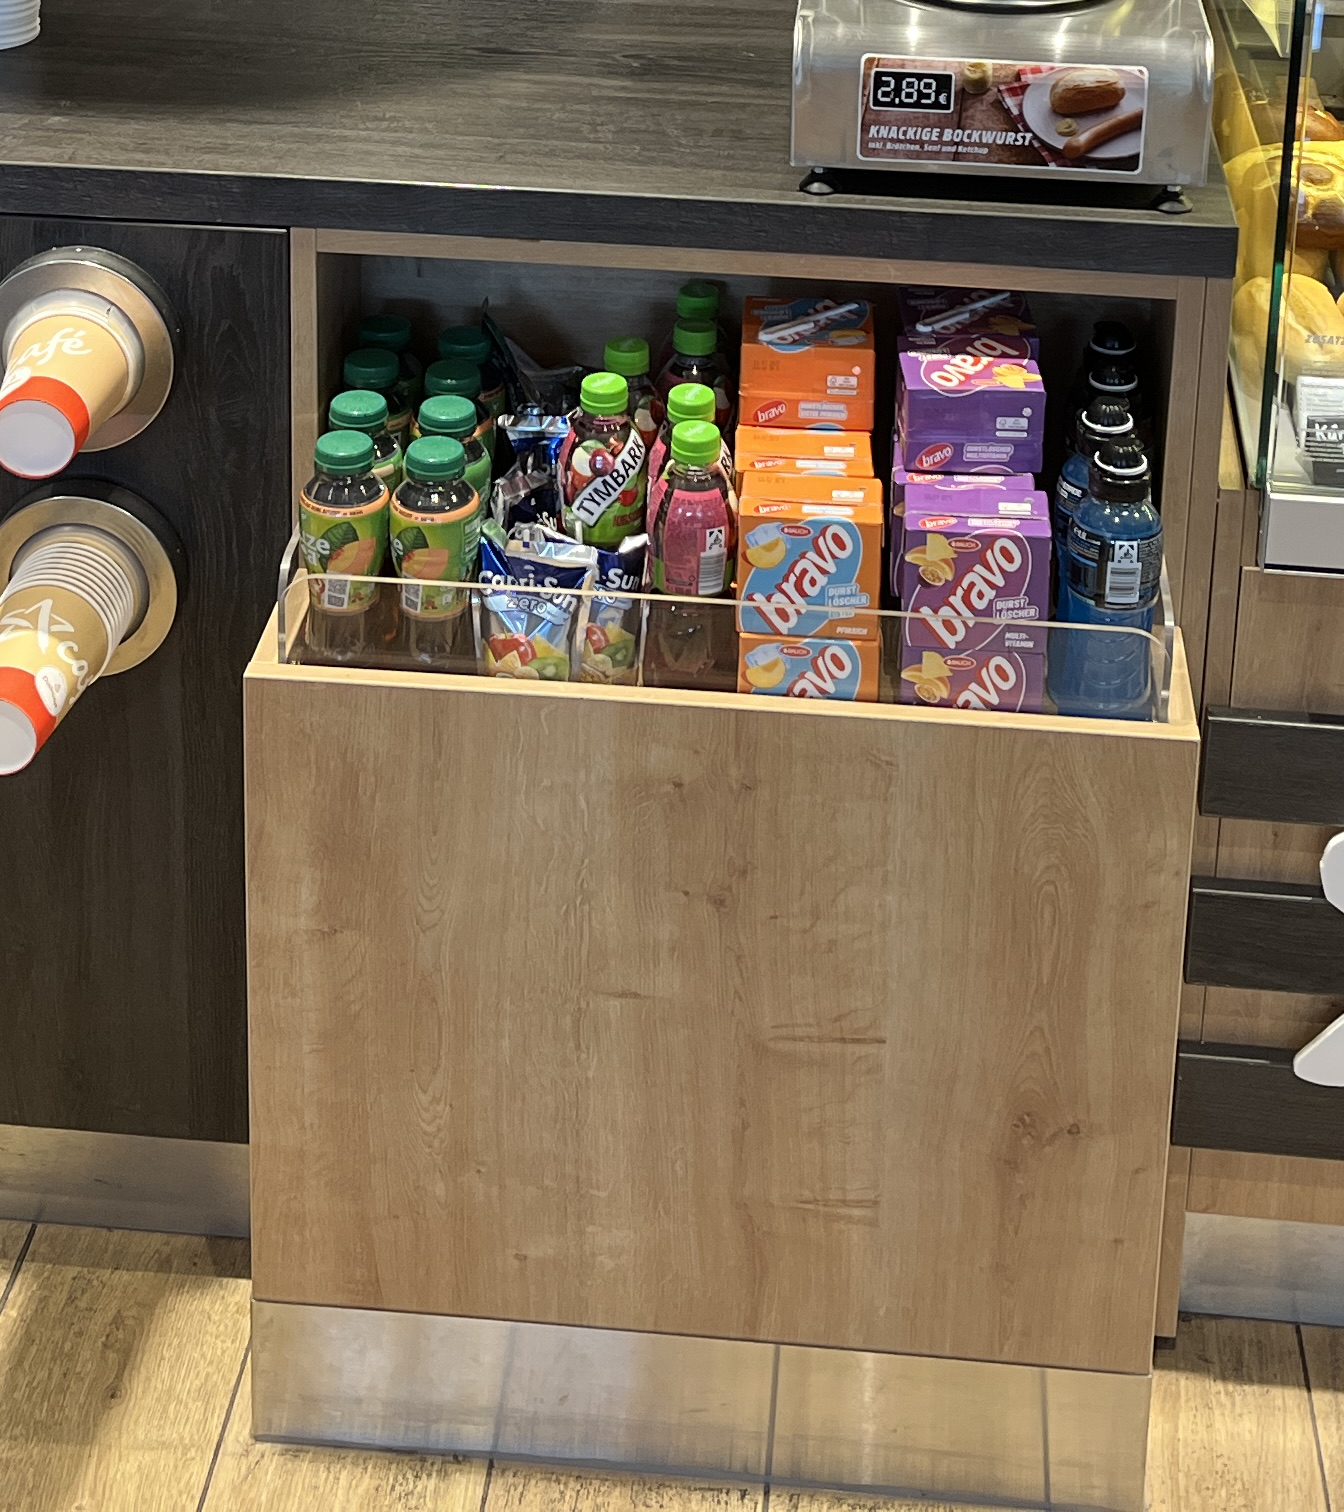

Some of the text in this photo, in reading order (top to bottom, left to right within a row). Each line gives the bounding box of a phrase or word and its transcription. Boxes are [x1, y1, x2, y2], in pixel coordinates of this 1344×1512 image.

[868, 124, 1033, 147] KNACKIGE BOCKWURST
[756, 401, 787, 422] bravo
[920, 444, 953, 468] bravo
[576, 434, 646, 522] TYMBARK
[752, 523, 854, 636] bravo
[828, 586, 856, 596] DURST
[829, 594, 867, 606] LÖSCHER
[921, 538, 1024, 649] bravo
[995, 607, 1037, 620] LÖSCHER
[996, 599, 1025, 608] DURST
